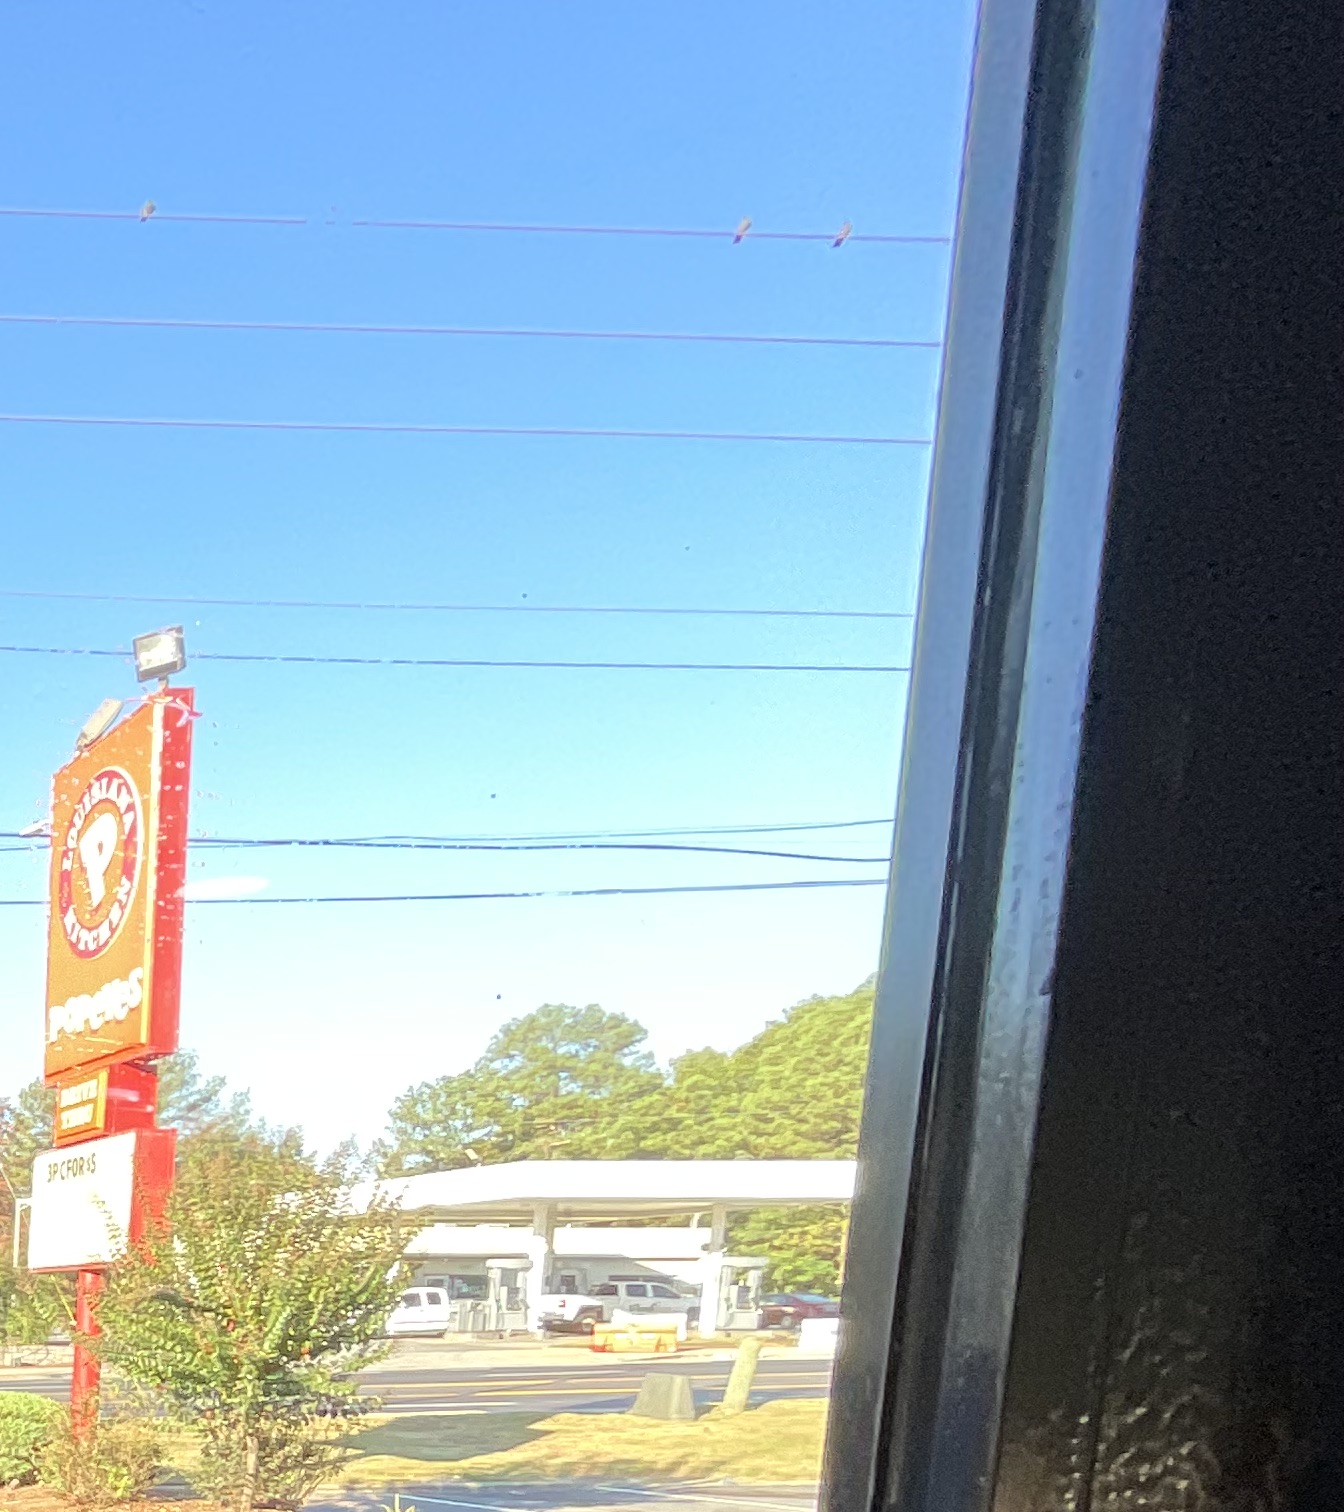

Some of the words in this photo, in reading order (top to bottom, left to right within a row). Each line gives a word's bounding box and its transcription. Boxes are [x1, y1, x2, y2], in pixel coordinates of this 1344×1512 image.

[63, 777, 135, 871] LOUISIANA
[64, 875, 131, 952] KITCHEN
[49, 966, 144, 1043] POPEYES
